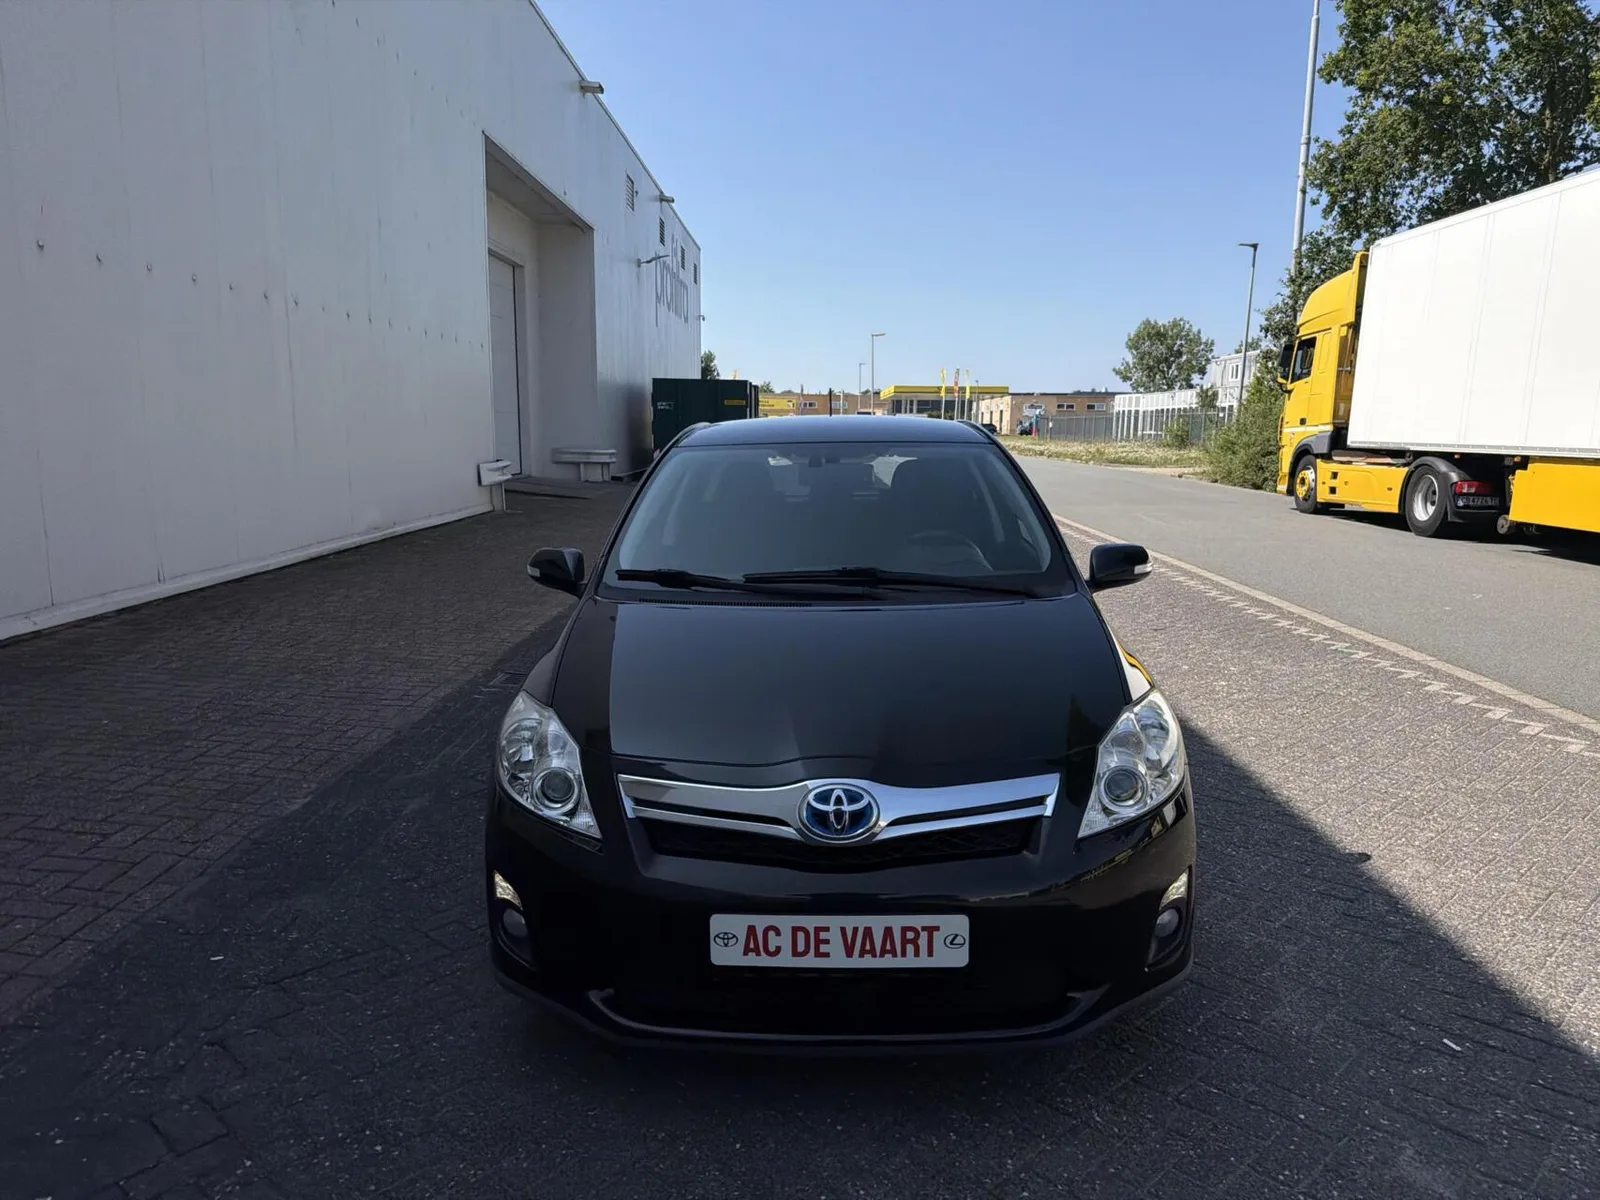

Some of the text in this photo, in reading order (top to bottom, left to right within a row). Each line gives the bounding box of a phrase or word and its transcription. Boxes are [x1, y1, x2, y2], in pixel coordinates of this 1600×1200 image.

[742, 924, 941, 958] AC DE VAART
